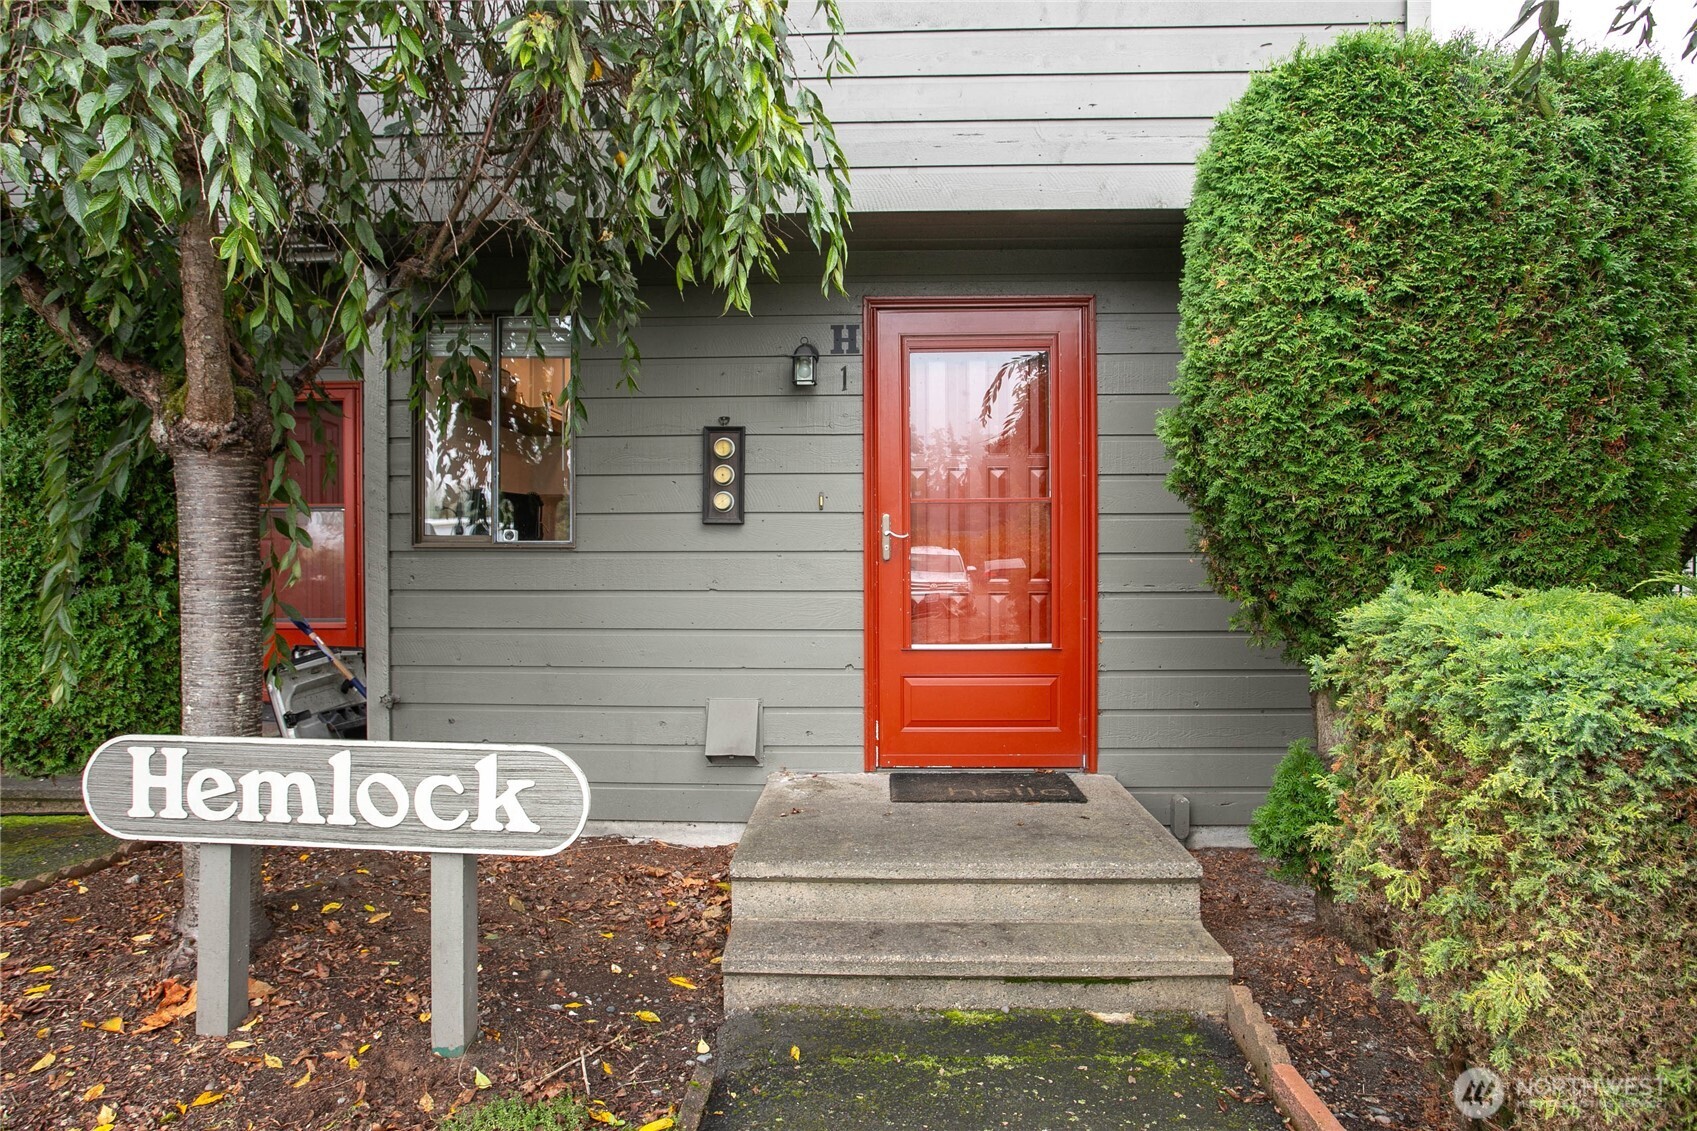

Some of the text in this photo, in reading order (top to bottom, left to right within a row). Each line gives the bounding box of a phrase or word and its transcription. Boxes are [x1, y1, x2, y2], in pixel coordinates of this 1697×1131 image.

[830, 324, 860, 354] H
[840, 365, 848, 392] 1
[127, 746, 541, 833] Hemlock
